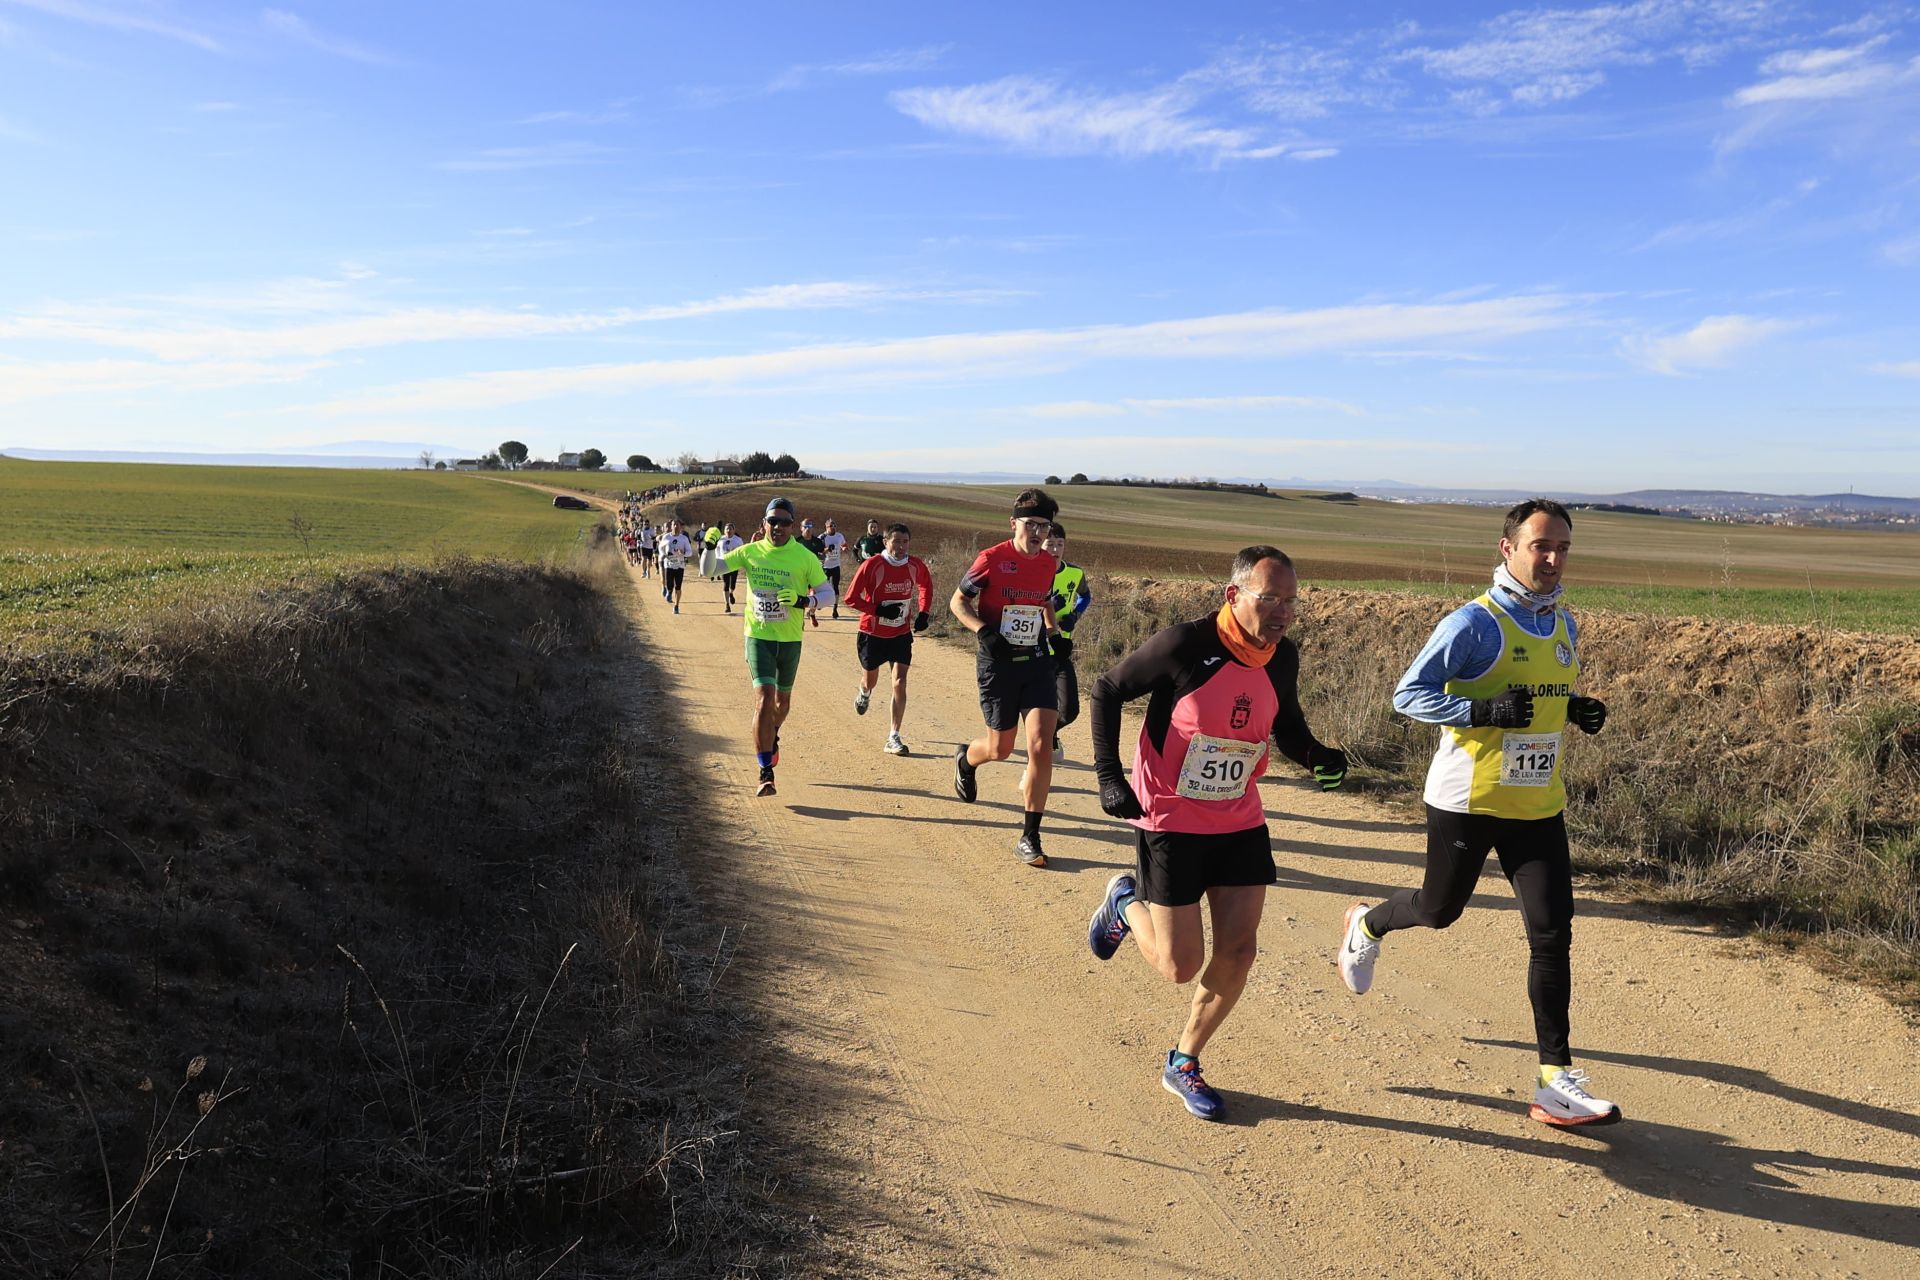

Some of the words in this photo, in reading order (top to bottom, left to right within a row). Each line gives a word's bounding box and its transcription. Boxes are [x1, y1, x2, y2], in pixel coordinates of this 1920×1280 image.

[761, 567, 790, 577] marcha
[751, 574, 774, 582] contra
[758, 601, 780, 612] 382
[1011, 618, 1035, 633] 351
[1516, 753, 1556, 770] 1120
[1201, 760, 1244, 781] 510
[1510, 769, 1520, 778] 32
[1188, 780, 1200, 790] 32
